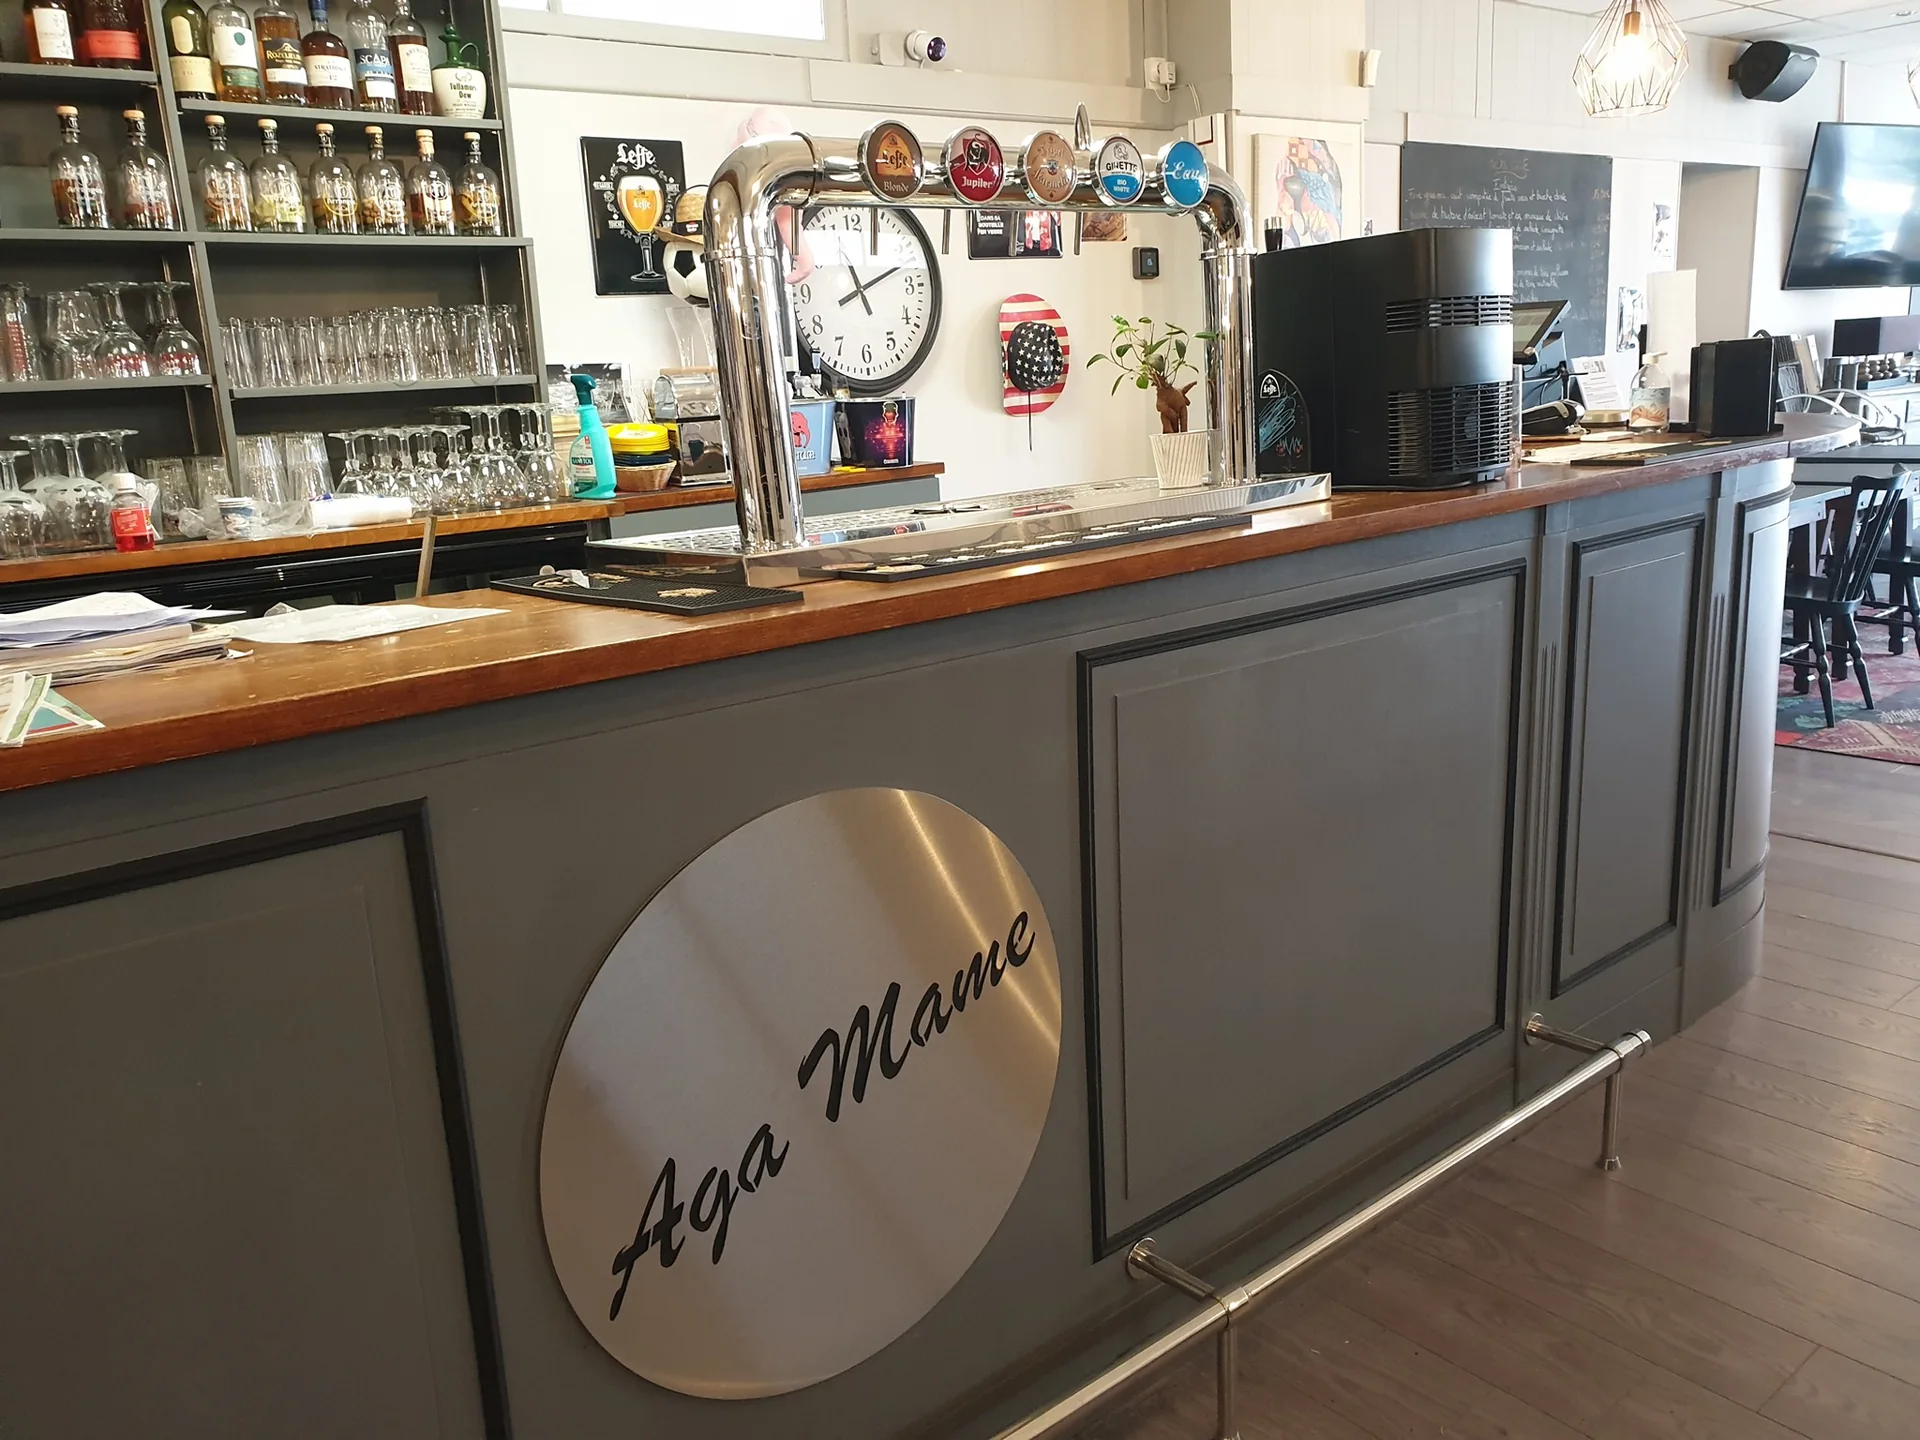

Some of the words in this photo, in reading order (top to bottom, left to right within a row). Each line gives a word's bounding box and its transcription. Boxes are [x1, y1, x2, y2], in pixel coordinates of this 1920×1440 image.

[459, 91, 472, 99] Dew
[616, 143, 656, 169] Leffe
[883, 181, 909, 192] Blonde
[961, 176, 993, 189] Jupiler
[1113, 186, 1131, 194] WHITE
[843, 213, 862, 233] 12
[800, 284, 811, 304] 9
[905, 275, 915, 295] 3
[812, 314, 823, 335] 8
[901, 304, 912, 325] 4
[834, 335, 844, 356] 7
[886, 331, 896, 351] 5
[862, 343, 872, 364] 6
[609, 1123, 789, 1321] Aga
[797, 911, 1036, 1122] Mame
